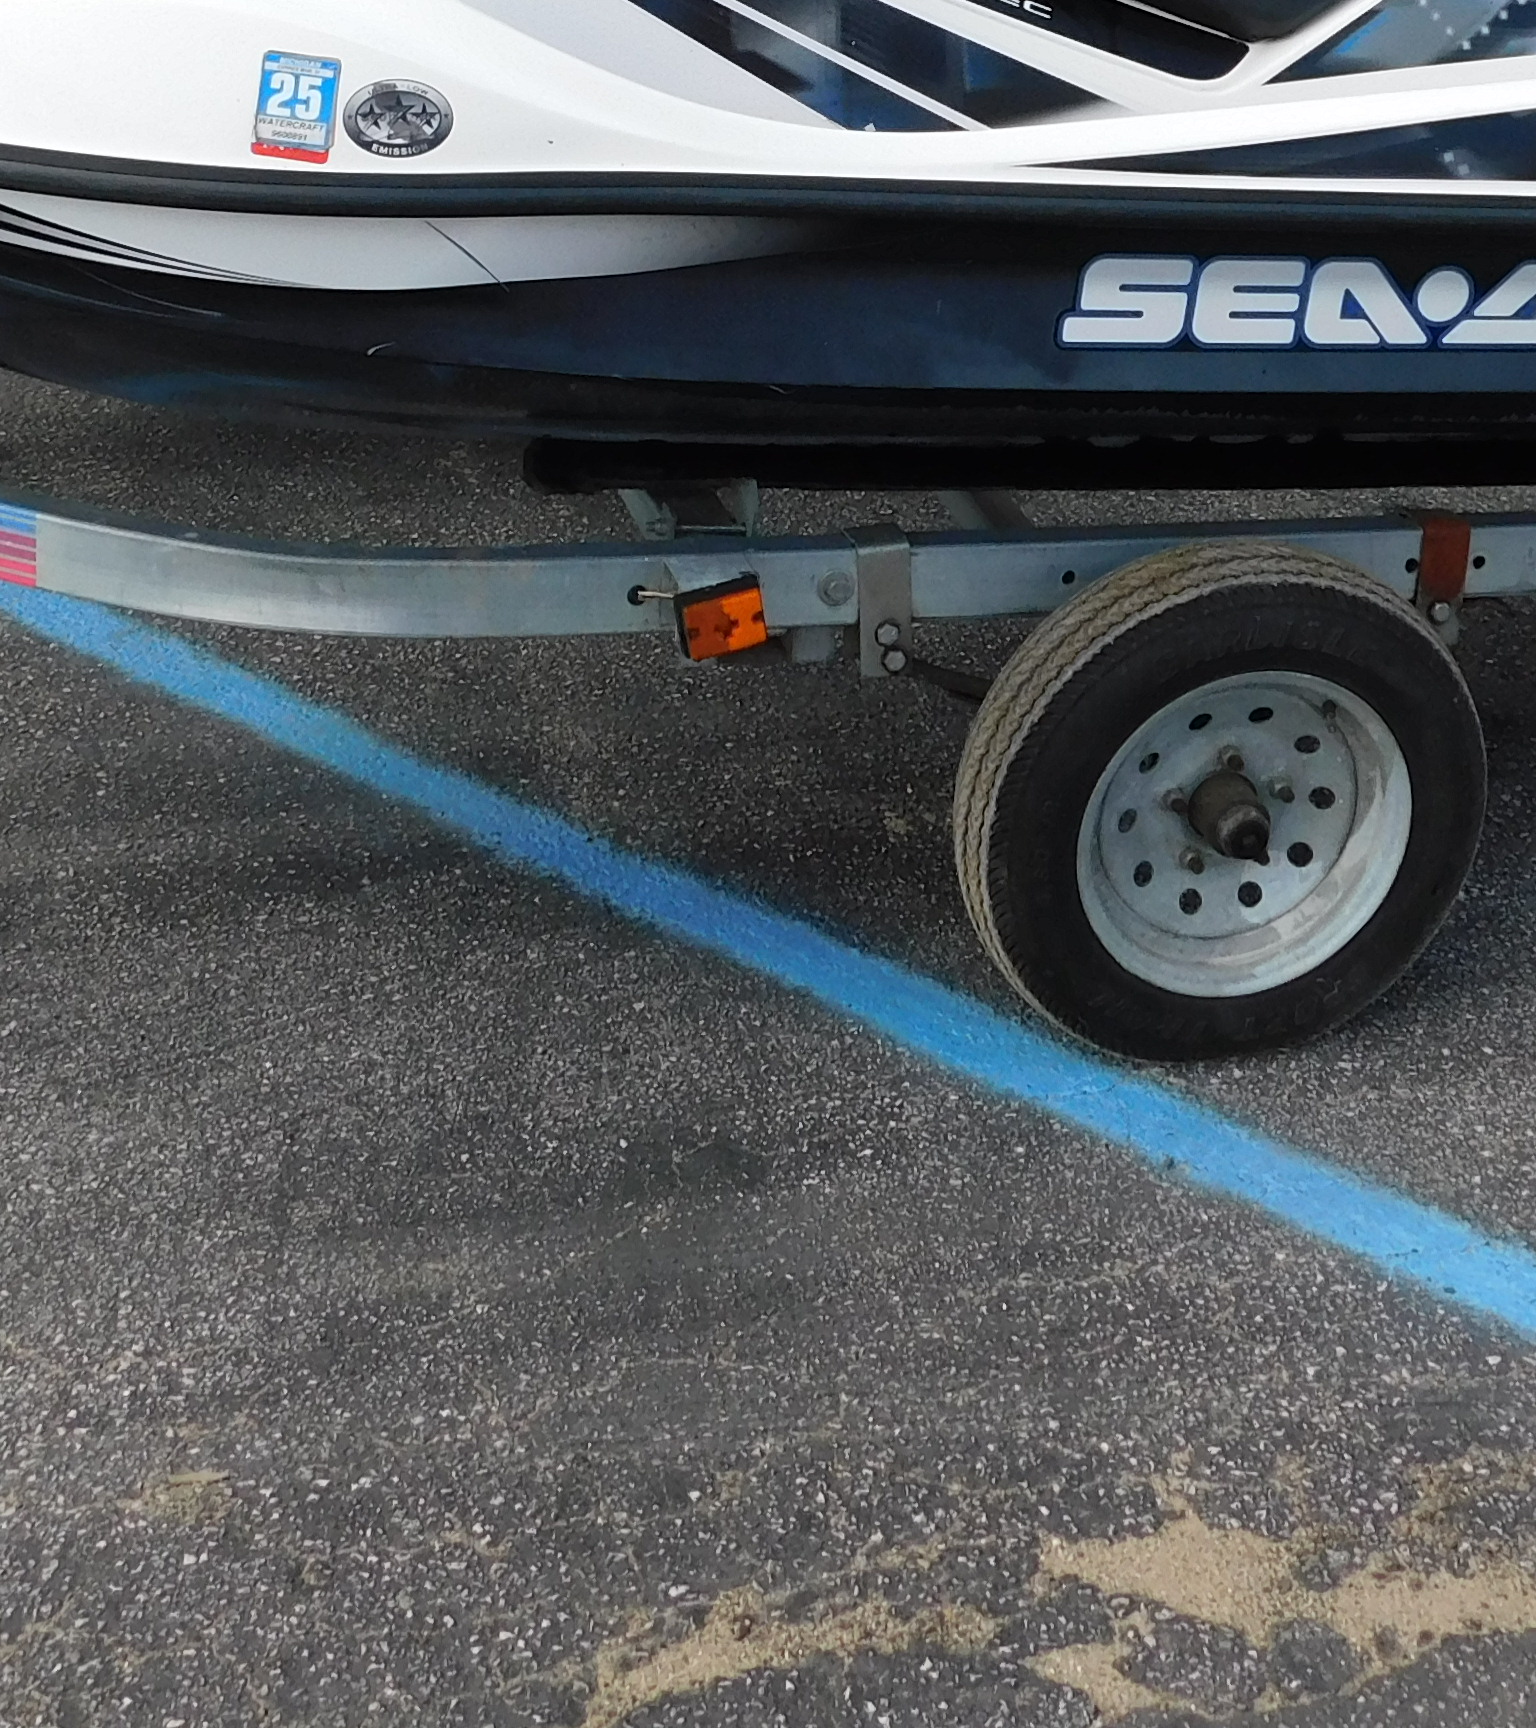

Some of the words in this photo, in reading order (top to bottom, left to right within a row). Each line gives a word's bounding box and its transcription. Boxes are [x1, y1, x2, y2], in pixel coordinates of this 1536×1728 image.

[266, 71, 323, 121] 25
[257, 118, 325, 132] WATERCRAFT
[371, 142, 429, 156] EMISSION
